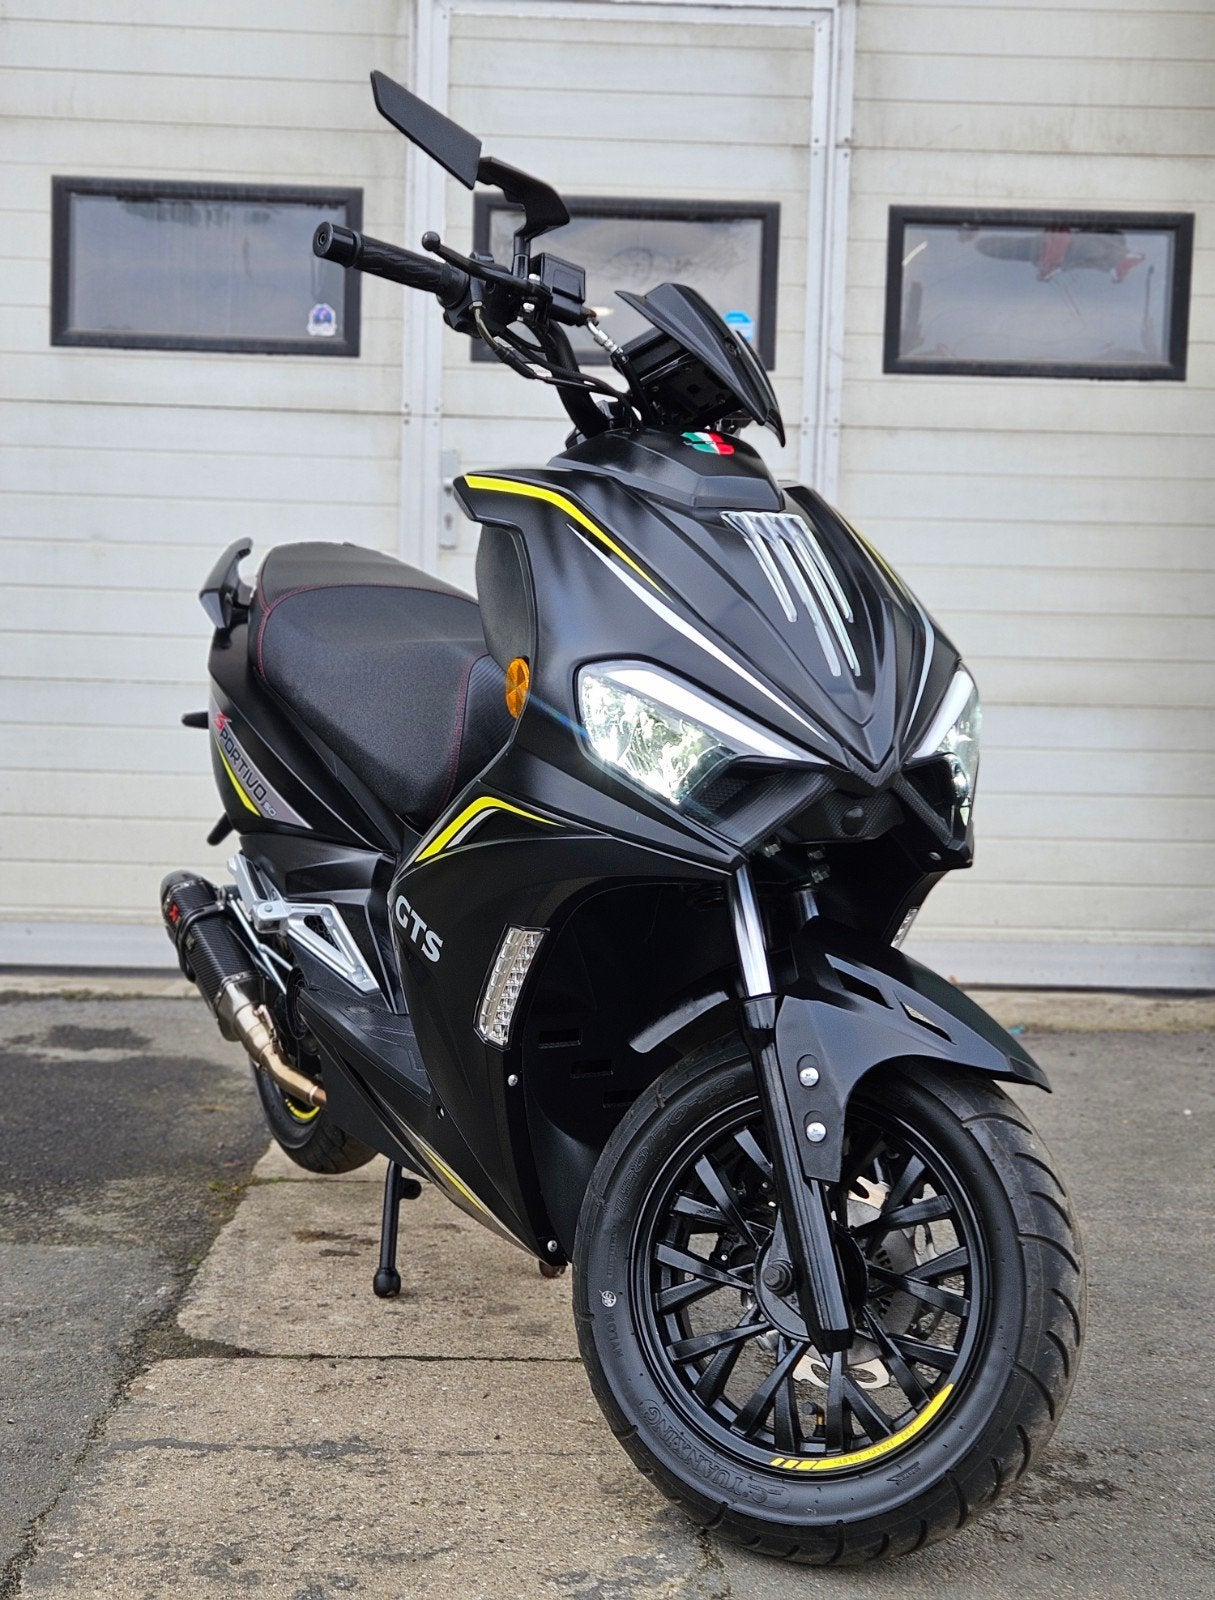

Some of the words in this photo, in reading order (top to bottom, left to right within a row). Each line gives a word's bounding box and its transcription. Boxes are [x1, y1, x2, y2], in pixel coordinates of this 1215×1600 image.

[213, 712, 267, 802] SPORTIVO
[395, 894, 444, 963] GTS
[643, 1406, 745, 1497] YUANXING
